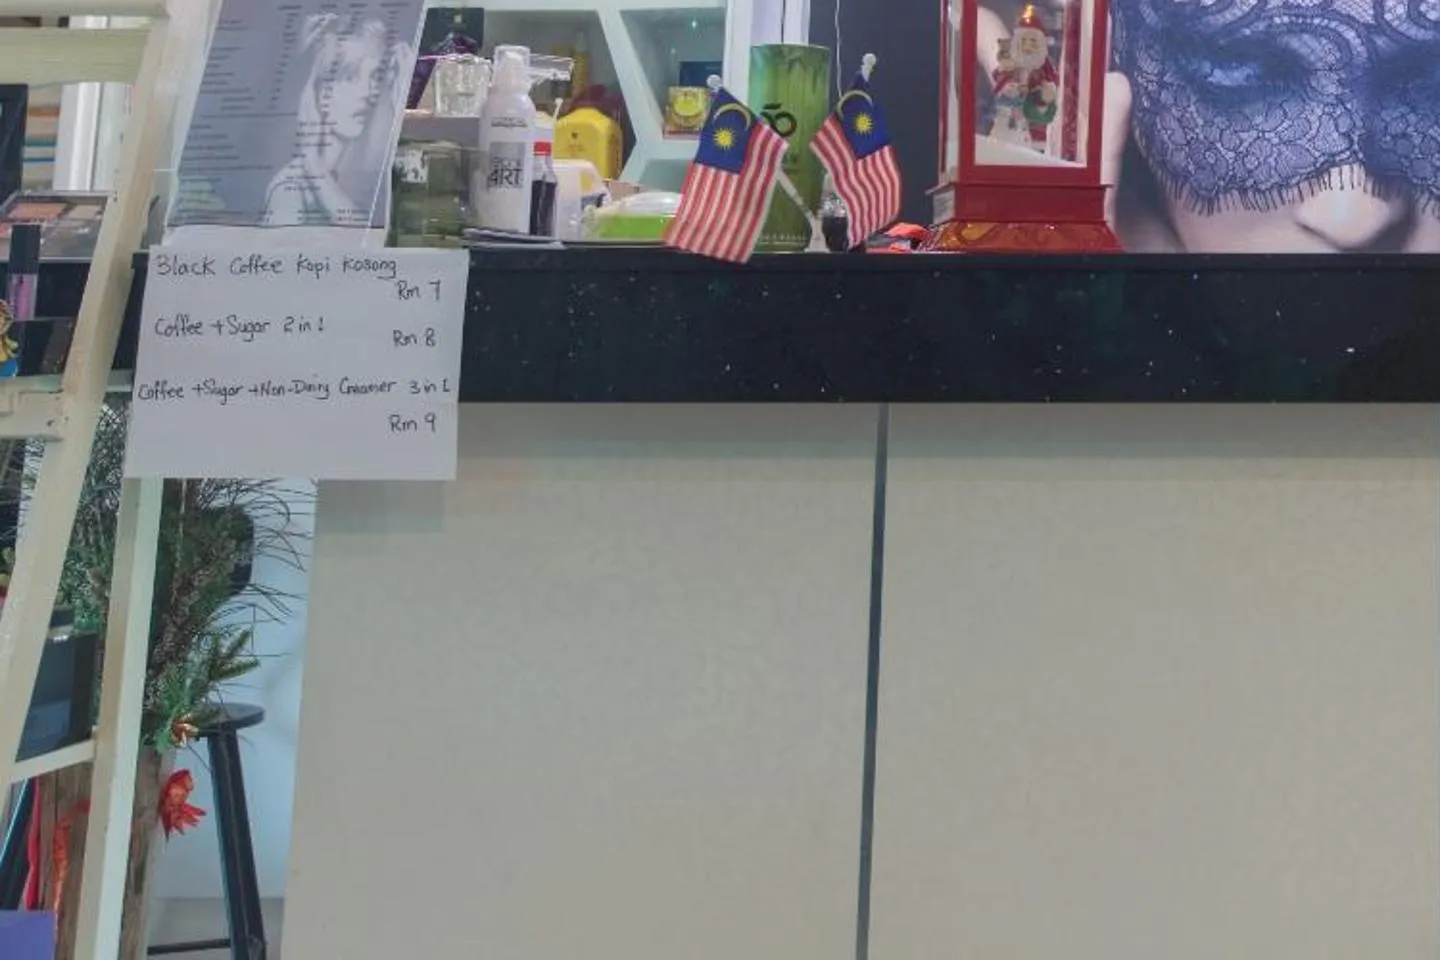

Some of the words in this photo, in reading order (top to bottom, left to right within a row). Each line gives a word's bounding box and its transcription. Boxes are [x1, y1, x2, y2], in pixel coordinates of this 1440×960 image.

[156, 253, 217, 276] Black
[229, 253, 284, 276] Coffee
[429, 279, 442, 300] 7
[154, 313, 204, 337] Coffee
[283, 316, 296, 333] 2
[137, 379, 185, 401] Coffee
[409, 380, 421, 395] 3
[424, 412, 437, 432] 9
